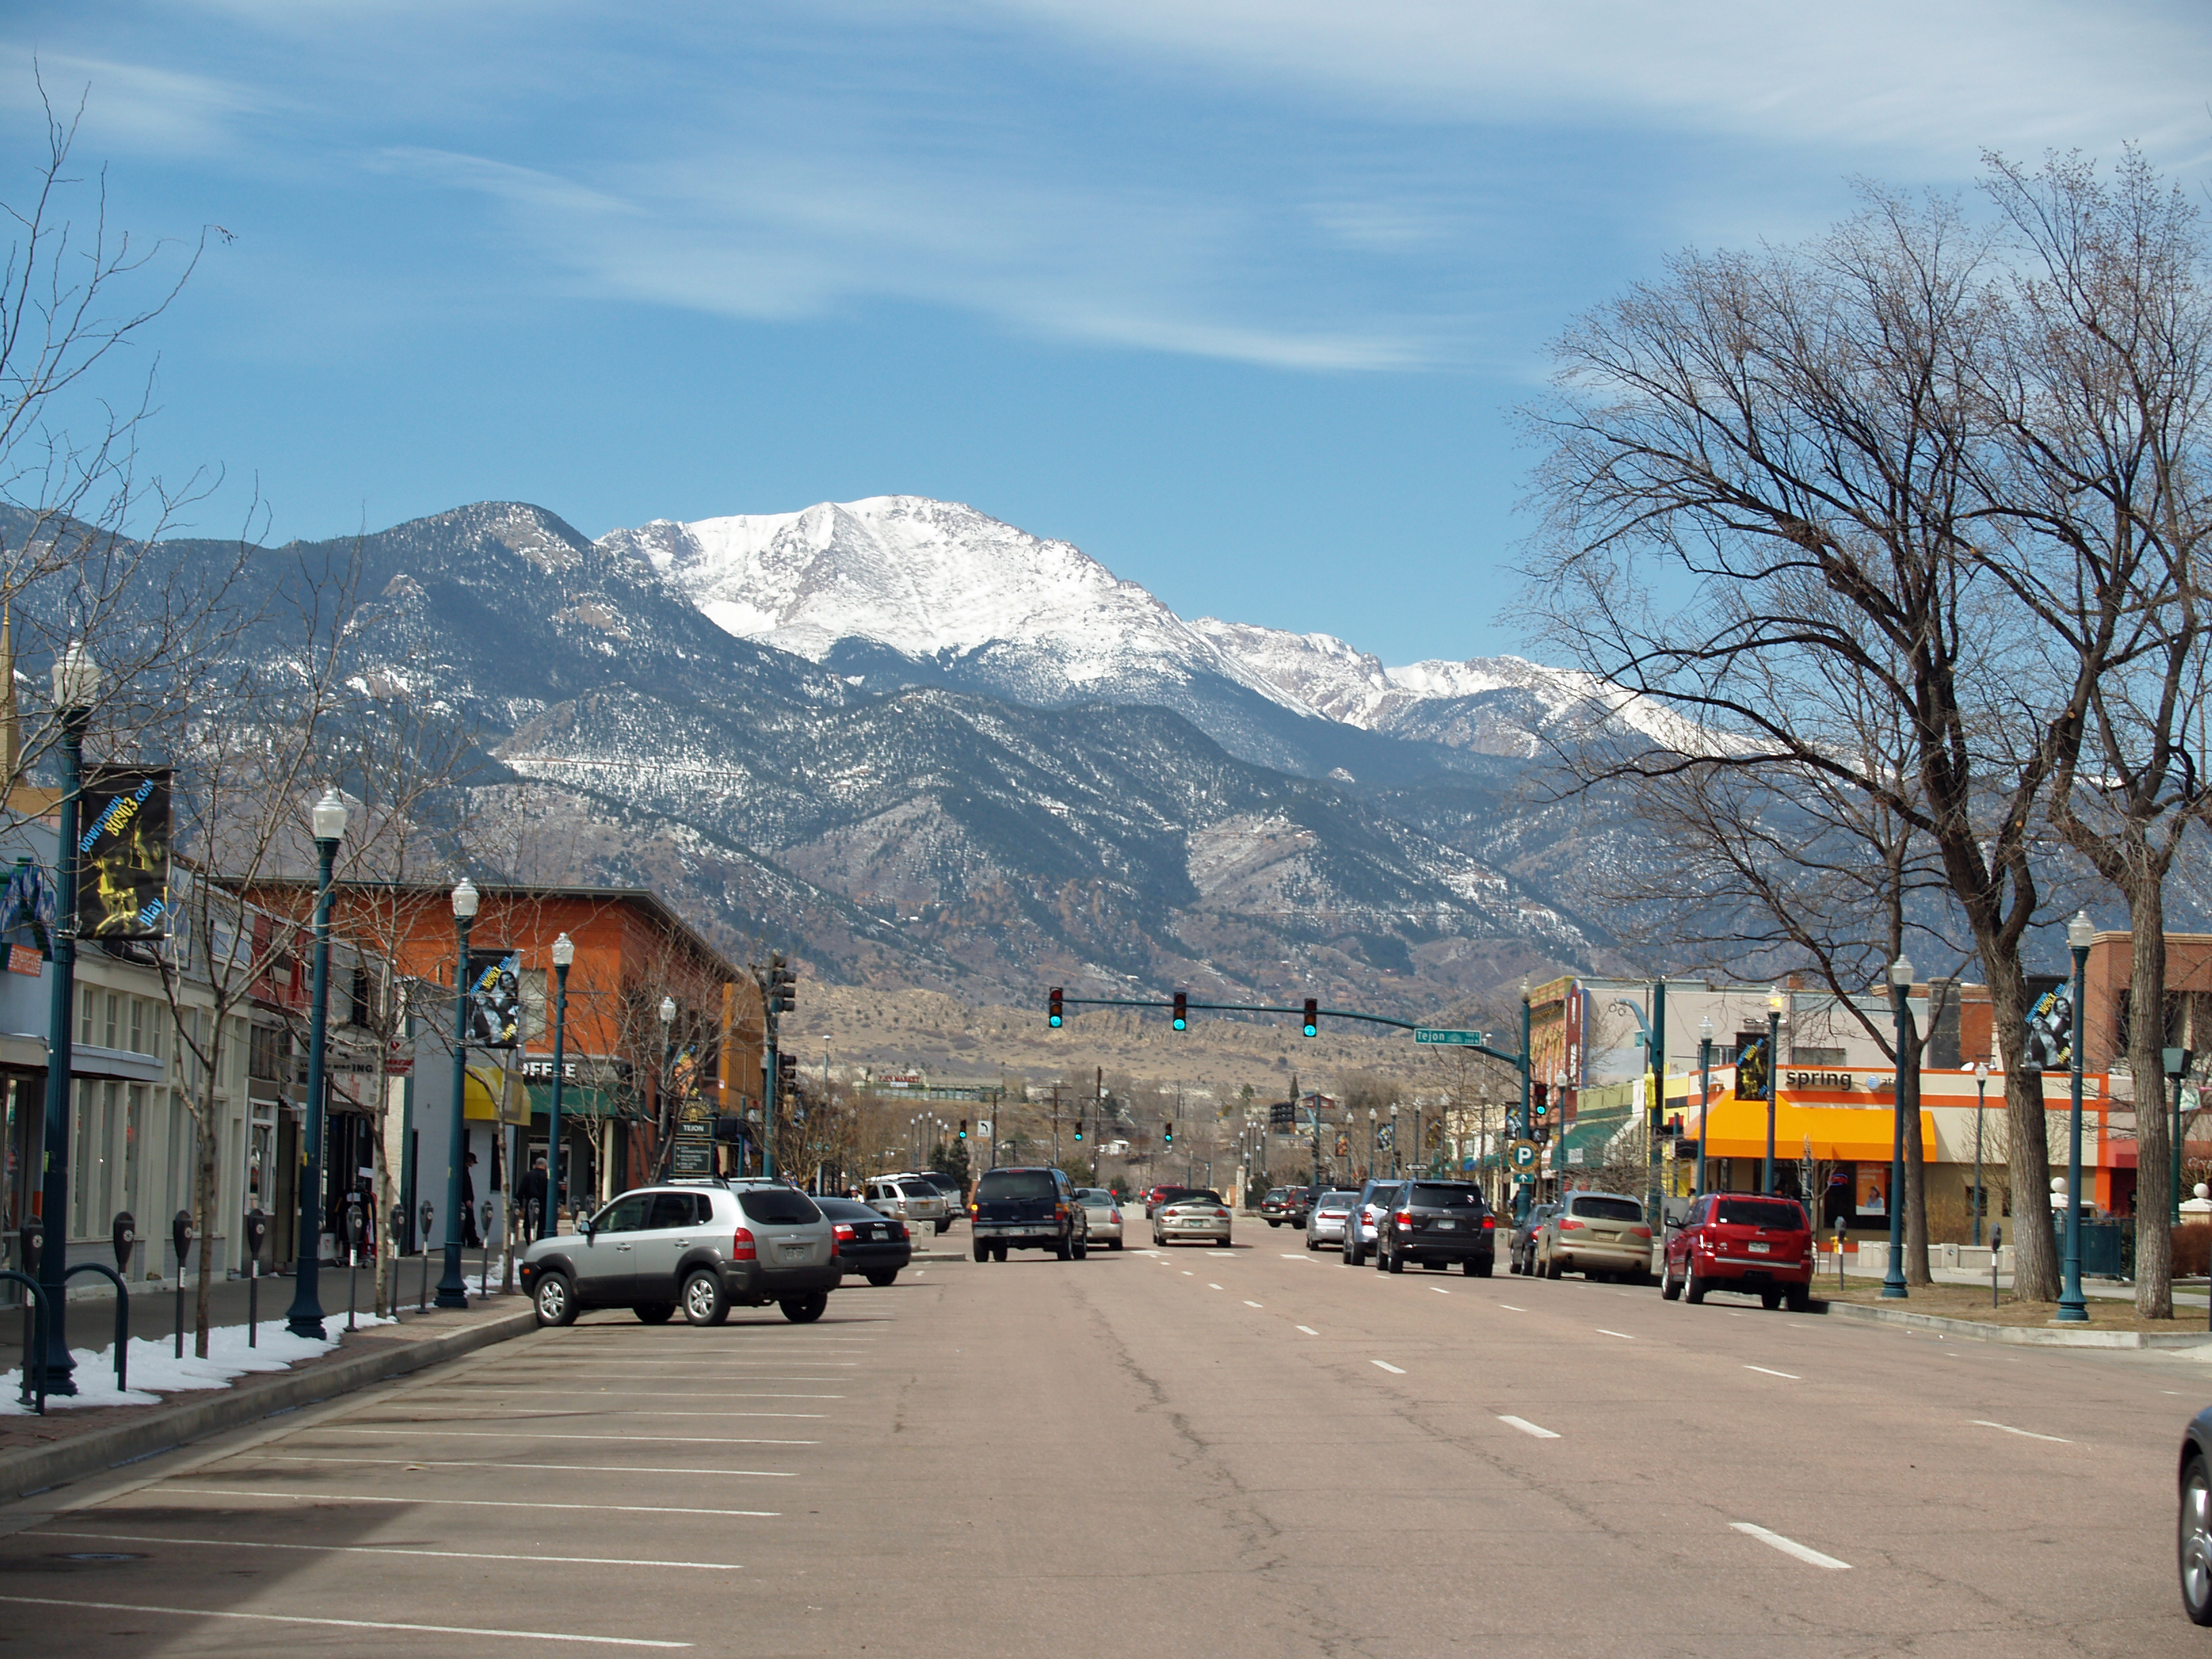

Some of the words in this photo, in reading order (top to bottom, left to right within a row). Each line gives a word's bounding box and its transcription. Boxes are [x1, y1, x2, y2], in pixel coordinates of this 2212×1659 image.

[79, 795, 124, 853] DOWNTOWN
[138, 897, 165, 927] play
[2025, 991, 2049, 1024] DOWNTOWN
[1417, 1031, 1445, 1042] Tejon
[352, 1063, 373, 1073] ING
[1786, 1070, 1851, 1090] spring
[1518, 1147, 1532, 1164] P
